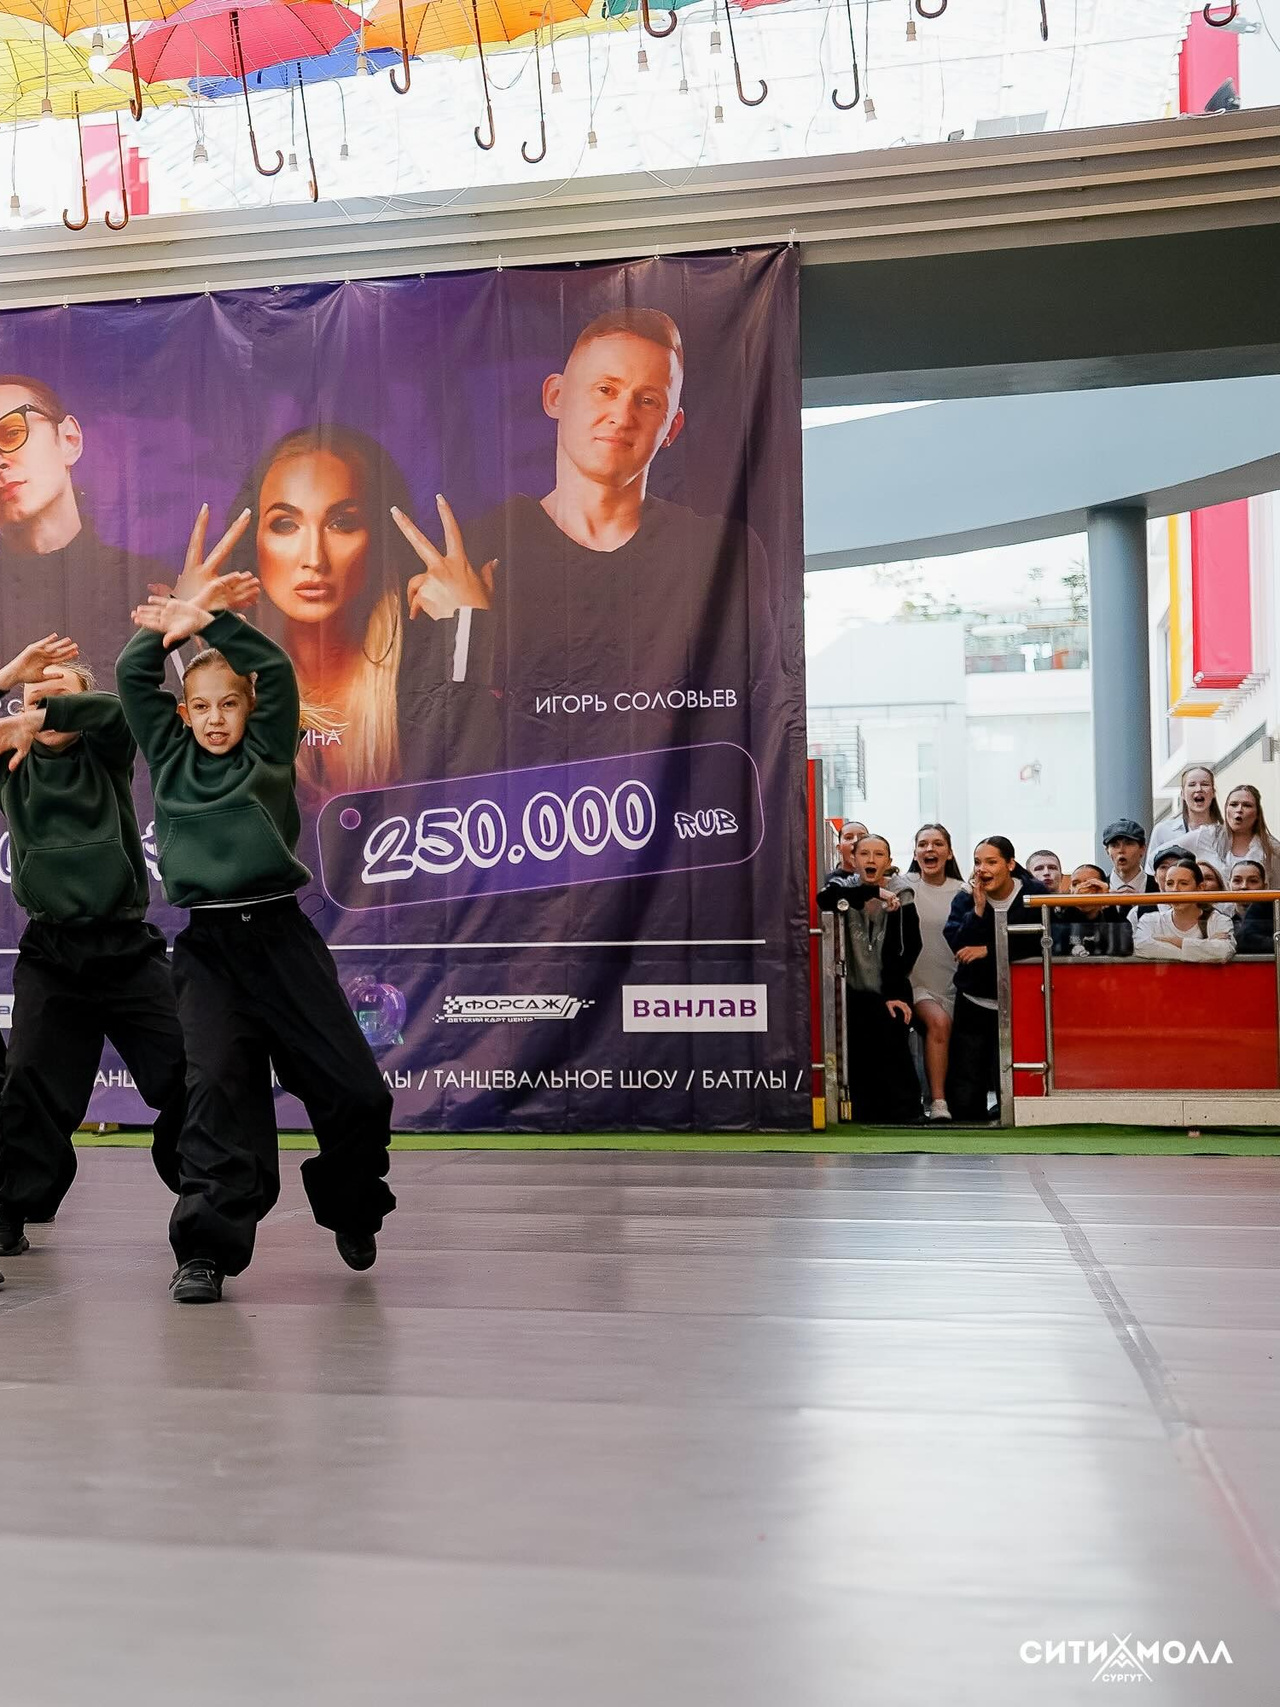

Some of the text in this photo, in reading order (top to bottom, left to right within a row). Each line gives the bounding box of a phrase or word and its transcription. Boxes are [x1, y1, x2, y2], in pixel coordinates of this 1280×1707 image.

[535, 689, 738, 714] ИГОРЬ СОЛОВЬЕВ
[361, 779, 739, 884] 250.000 RUB
[465, 999, 562, 1010] ФОРСАЖ
[632, 998, 758, 1018] ванлав
[433, 1069, 613, 1090] ТАНЦЕВАЛЬНОЕ
[620, 1069, 678, 1089] ШОУ
[702, 1069, 787, 1089] БАТТЛЫ
